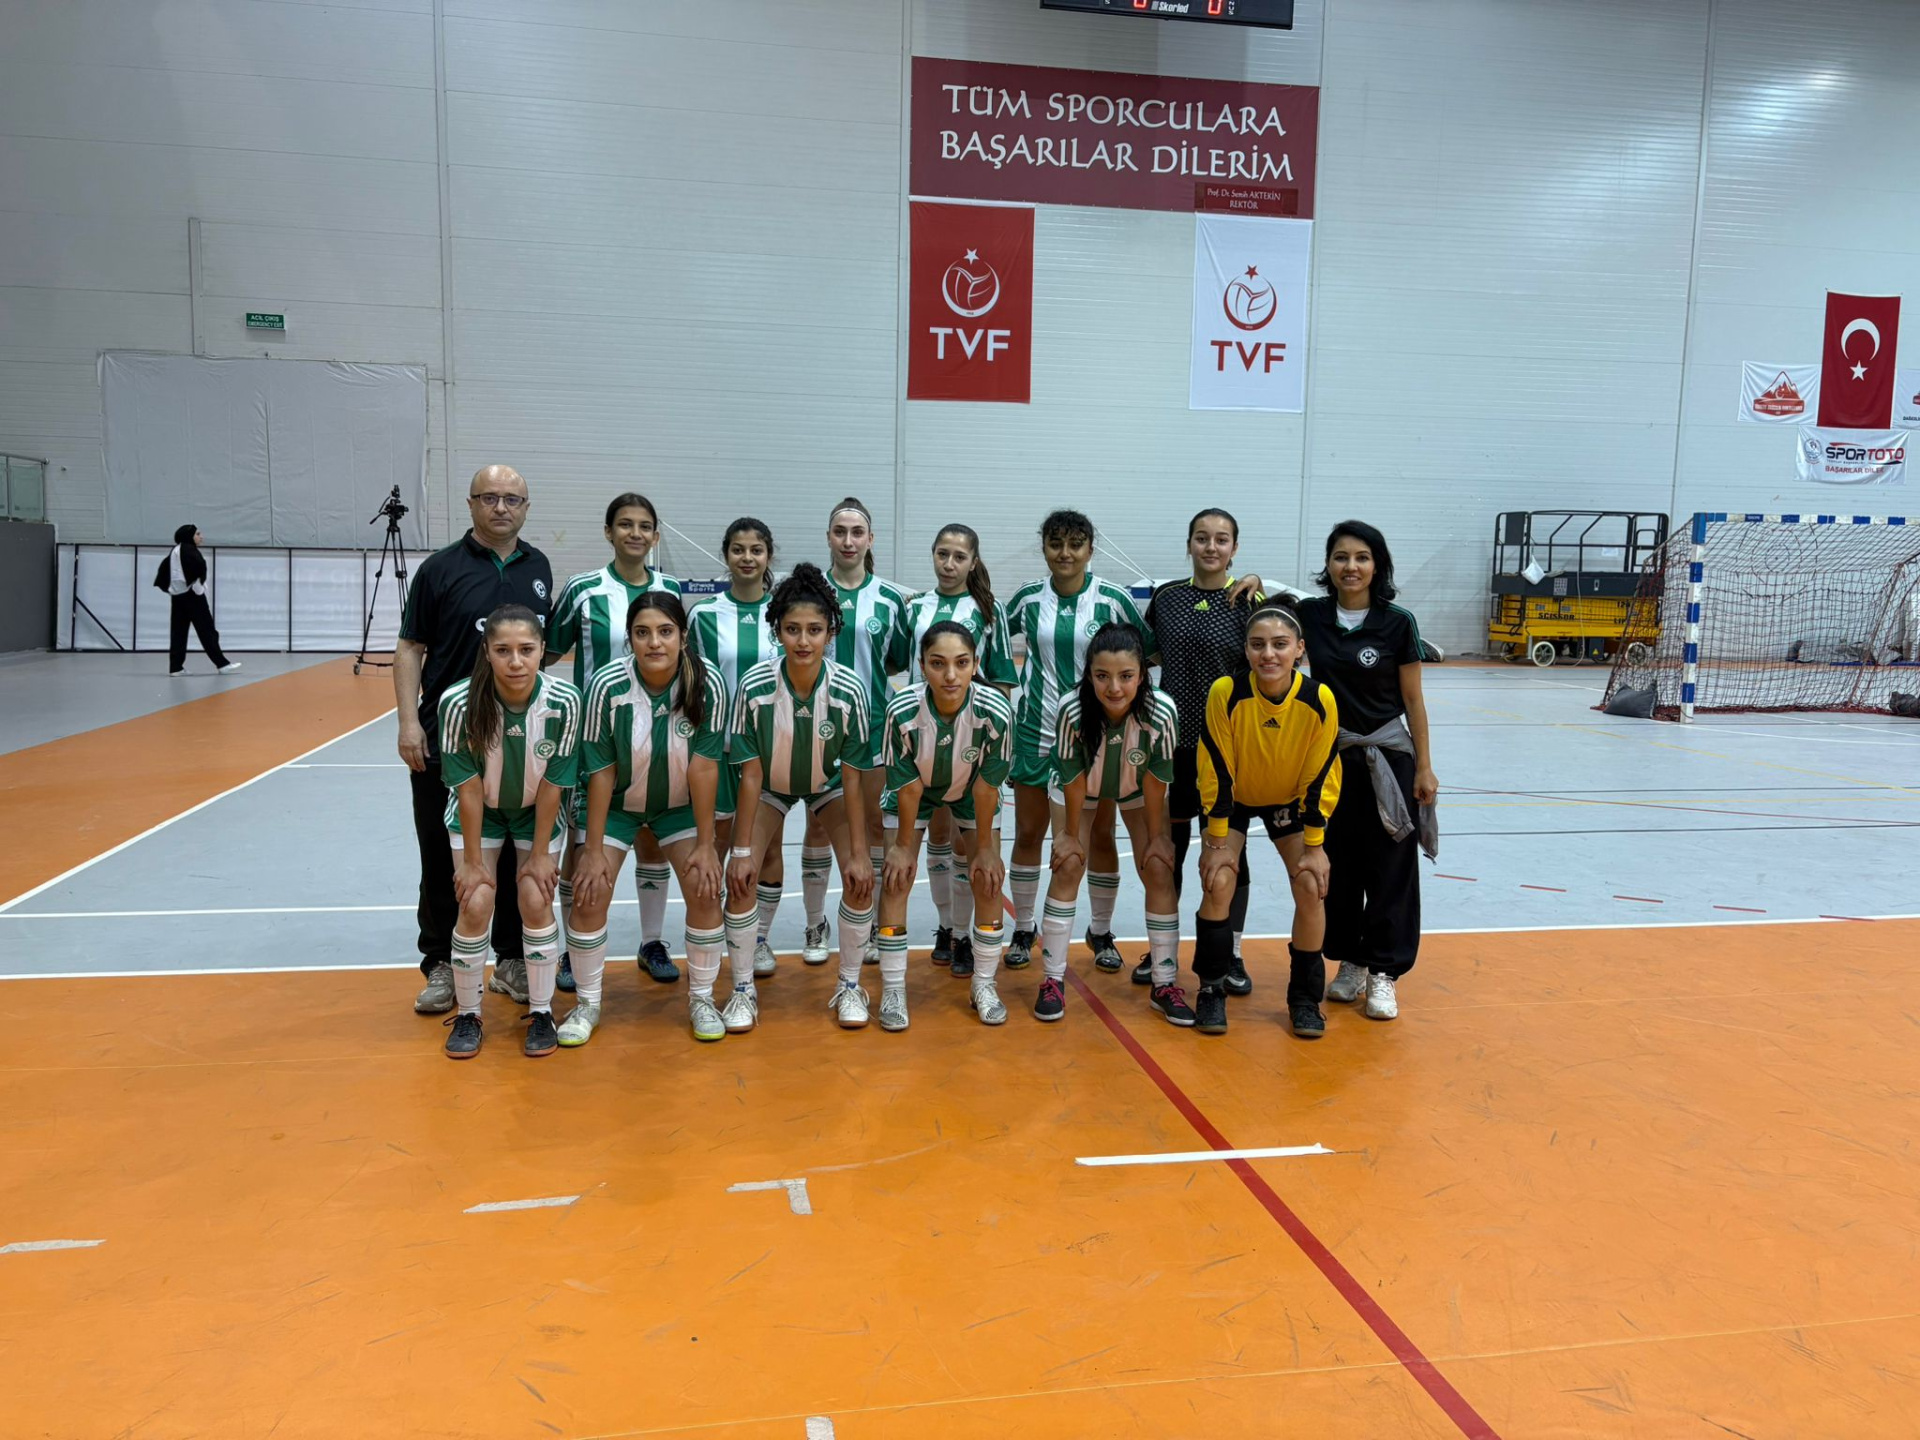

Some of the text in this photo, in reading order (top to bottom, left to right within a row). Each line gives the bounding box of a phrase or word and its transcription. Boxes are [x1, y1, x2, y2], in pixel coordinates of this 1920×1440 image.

[1159, 1, 1189, 13] Skorled
[942, 84, 1287, 137] TÜM SPORCULARA
[940, 130, 1294, 182] BAŞARILAR DİLERİM
[1229, 200, 1258, 209] REKTÖR
[1249, 191, 1281, 200] AKTEKİN
[929, 326, 1011, 362] TVF
[1210, 340, 1287, 373] TVF
